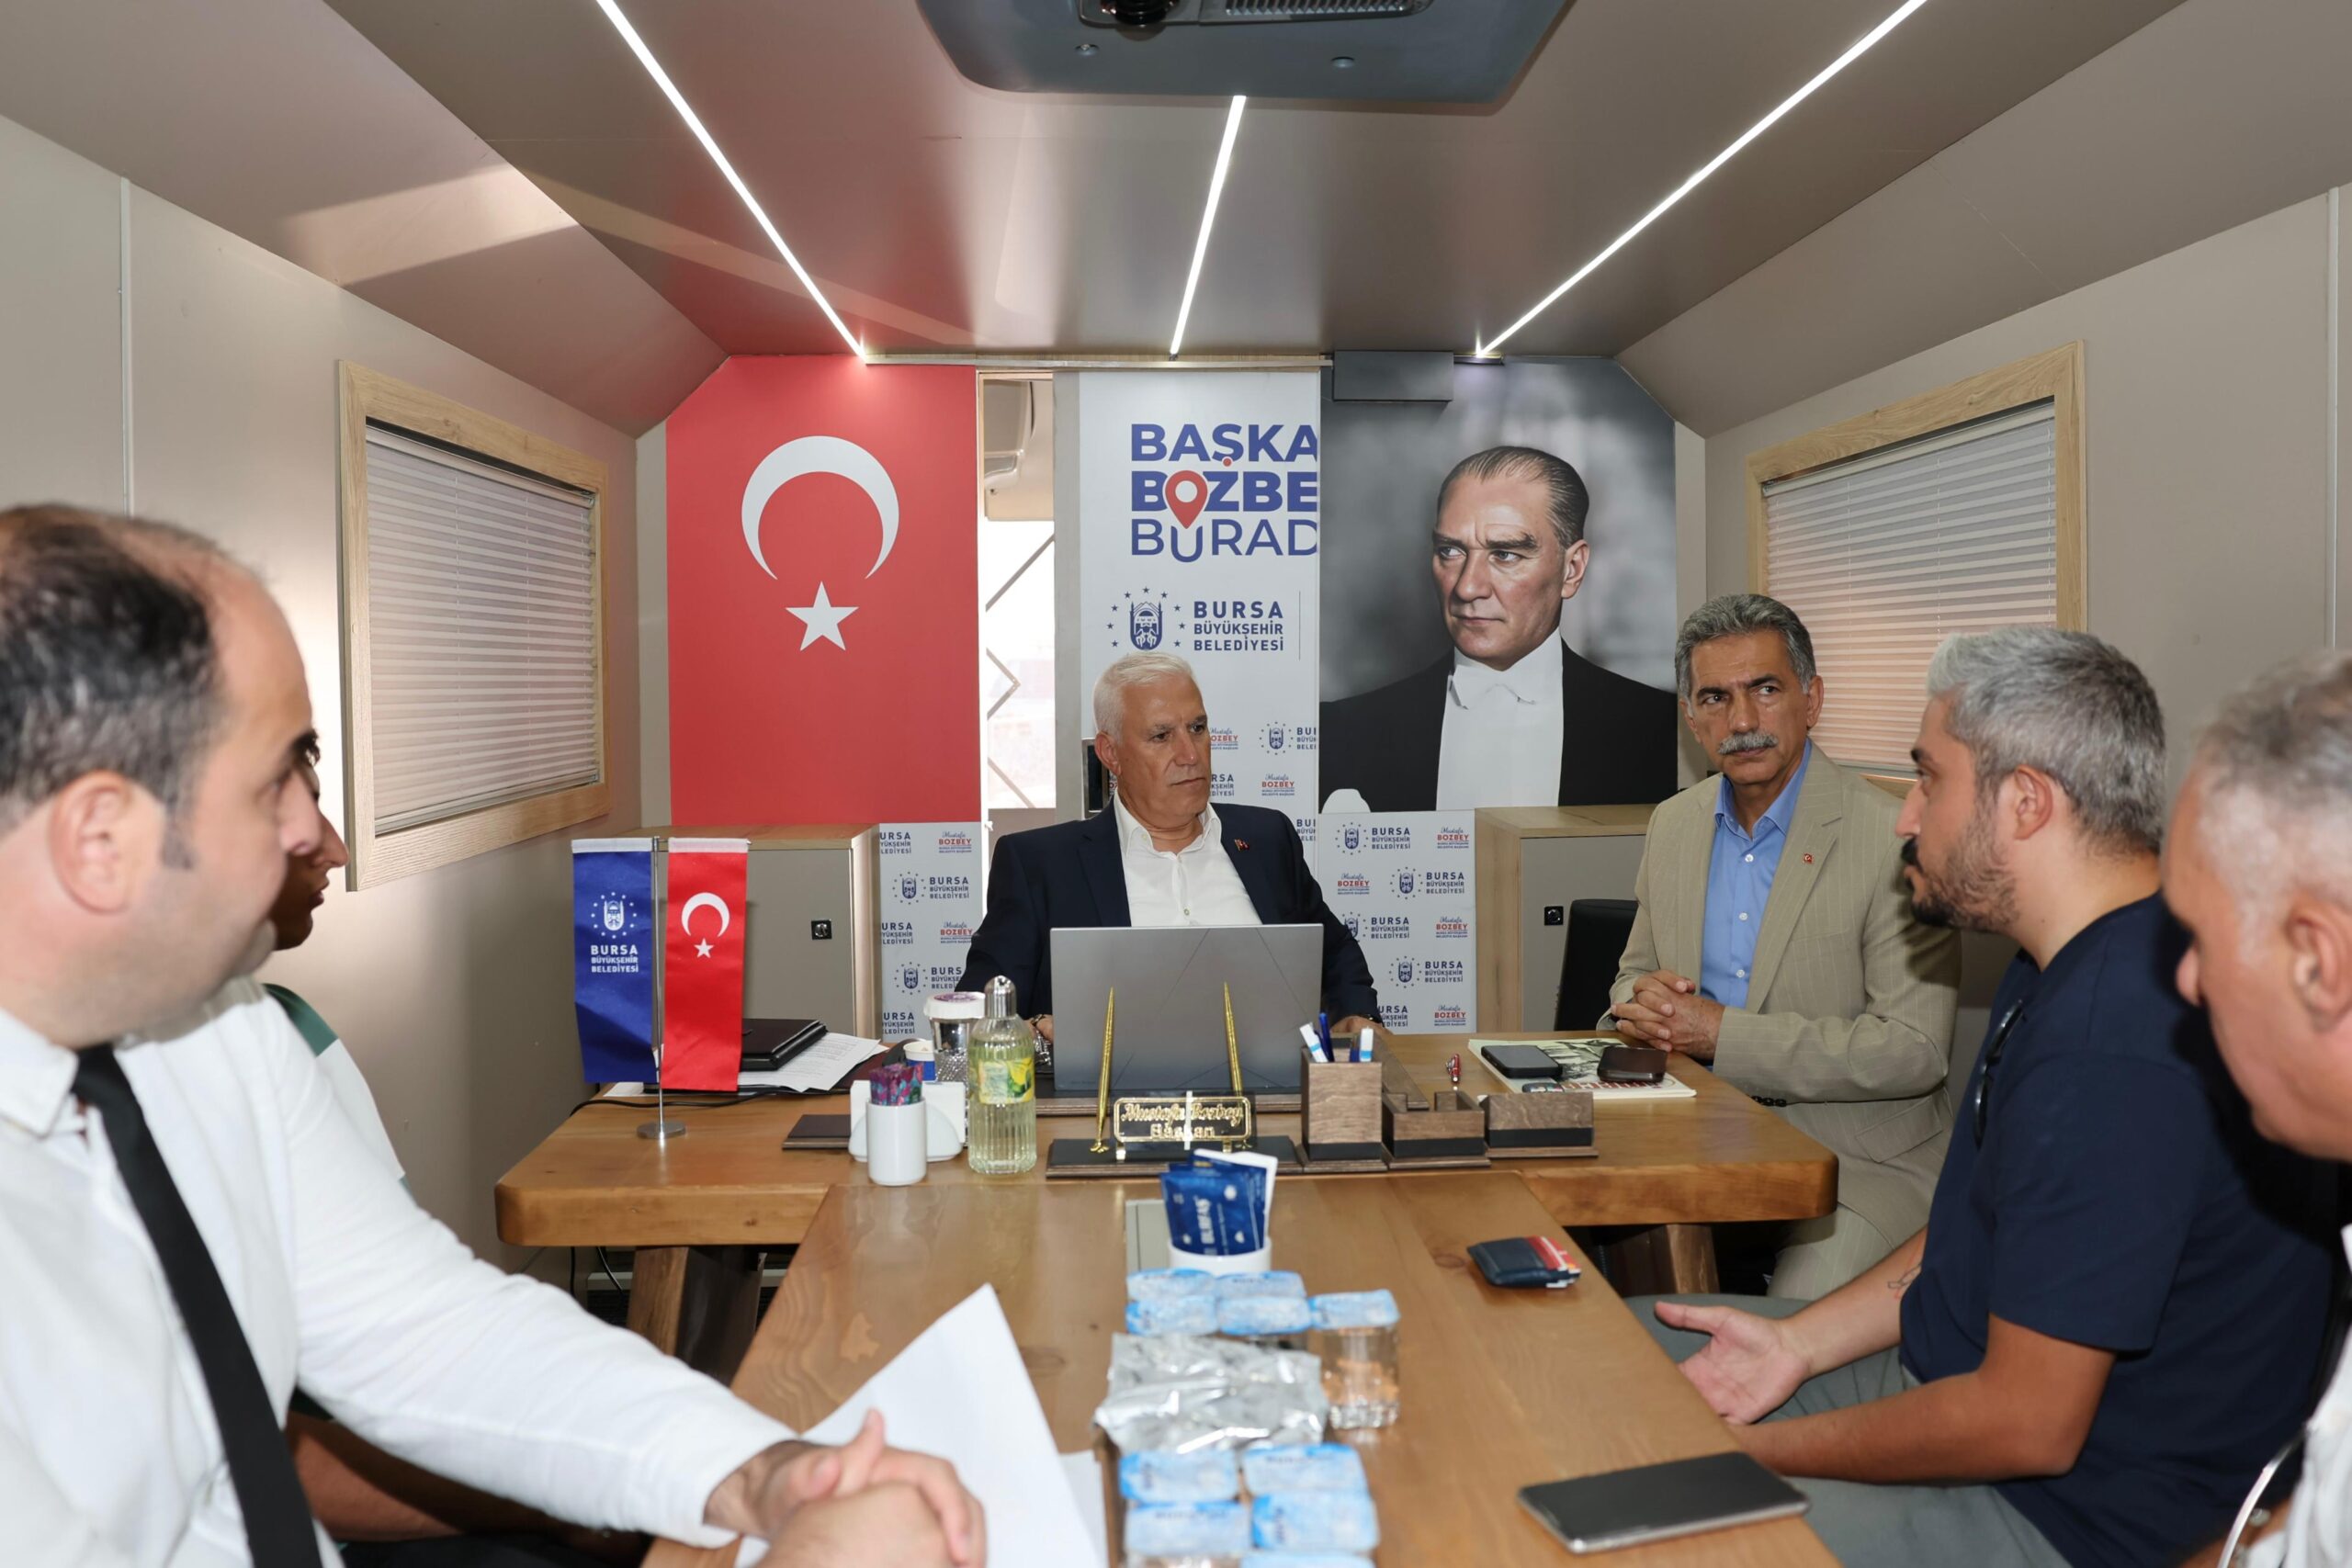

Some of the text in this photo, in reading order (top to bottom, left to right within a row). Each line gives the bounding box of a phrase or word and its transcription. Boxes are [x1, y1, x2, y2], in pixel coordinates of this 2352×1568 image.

[1132, 423, 1317, 467] BAŞKA
[1132, 519, 1317, 562] BURAD
[1193, 602, 1283, 619] BURSA
[1193, 620, 1283, 637] BÜYÜKŞEHİR
[1193, 636, 1284, 651] BELEDİYESİ
[1372, 827, 1410, 836] BURSA
[930, 876, 969, 885] BURSA
[1426, 872, 1464, 880] BURSA
[930, 891, 969, 899] BELEDİYESİ
[1371, 917, 1409, 925] BURSA
[591, 944, 639, 955] BURSA
[591, 955, 639, 964] BÜYÜKŞEHİR
[591, 964, 639, 973] BELEDİYESİ
[1425, 961, 1464, 969] BURSA
[931, 966, 962, 976] BURS
[1378, 1005, 1408, 1013] URSA
